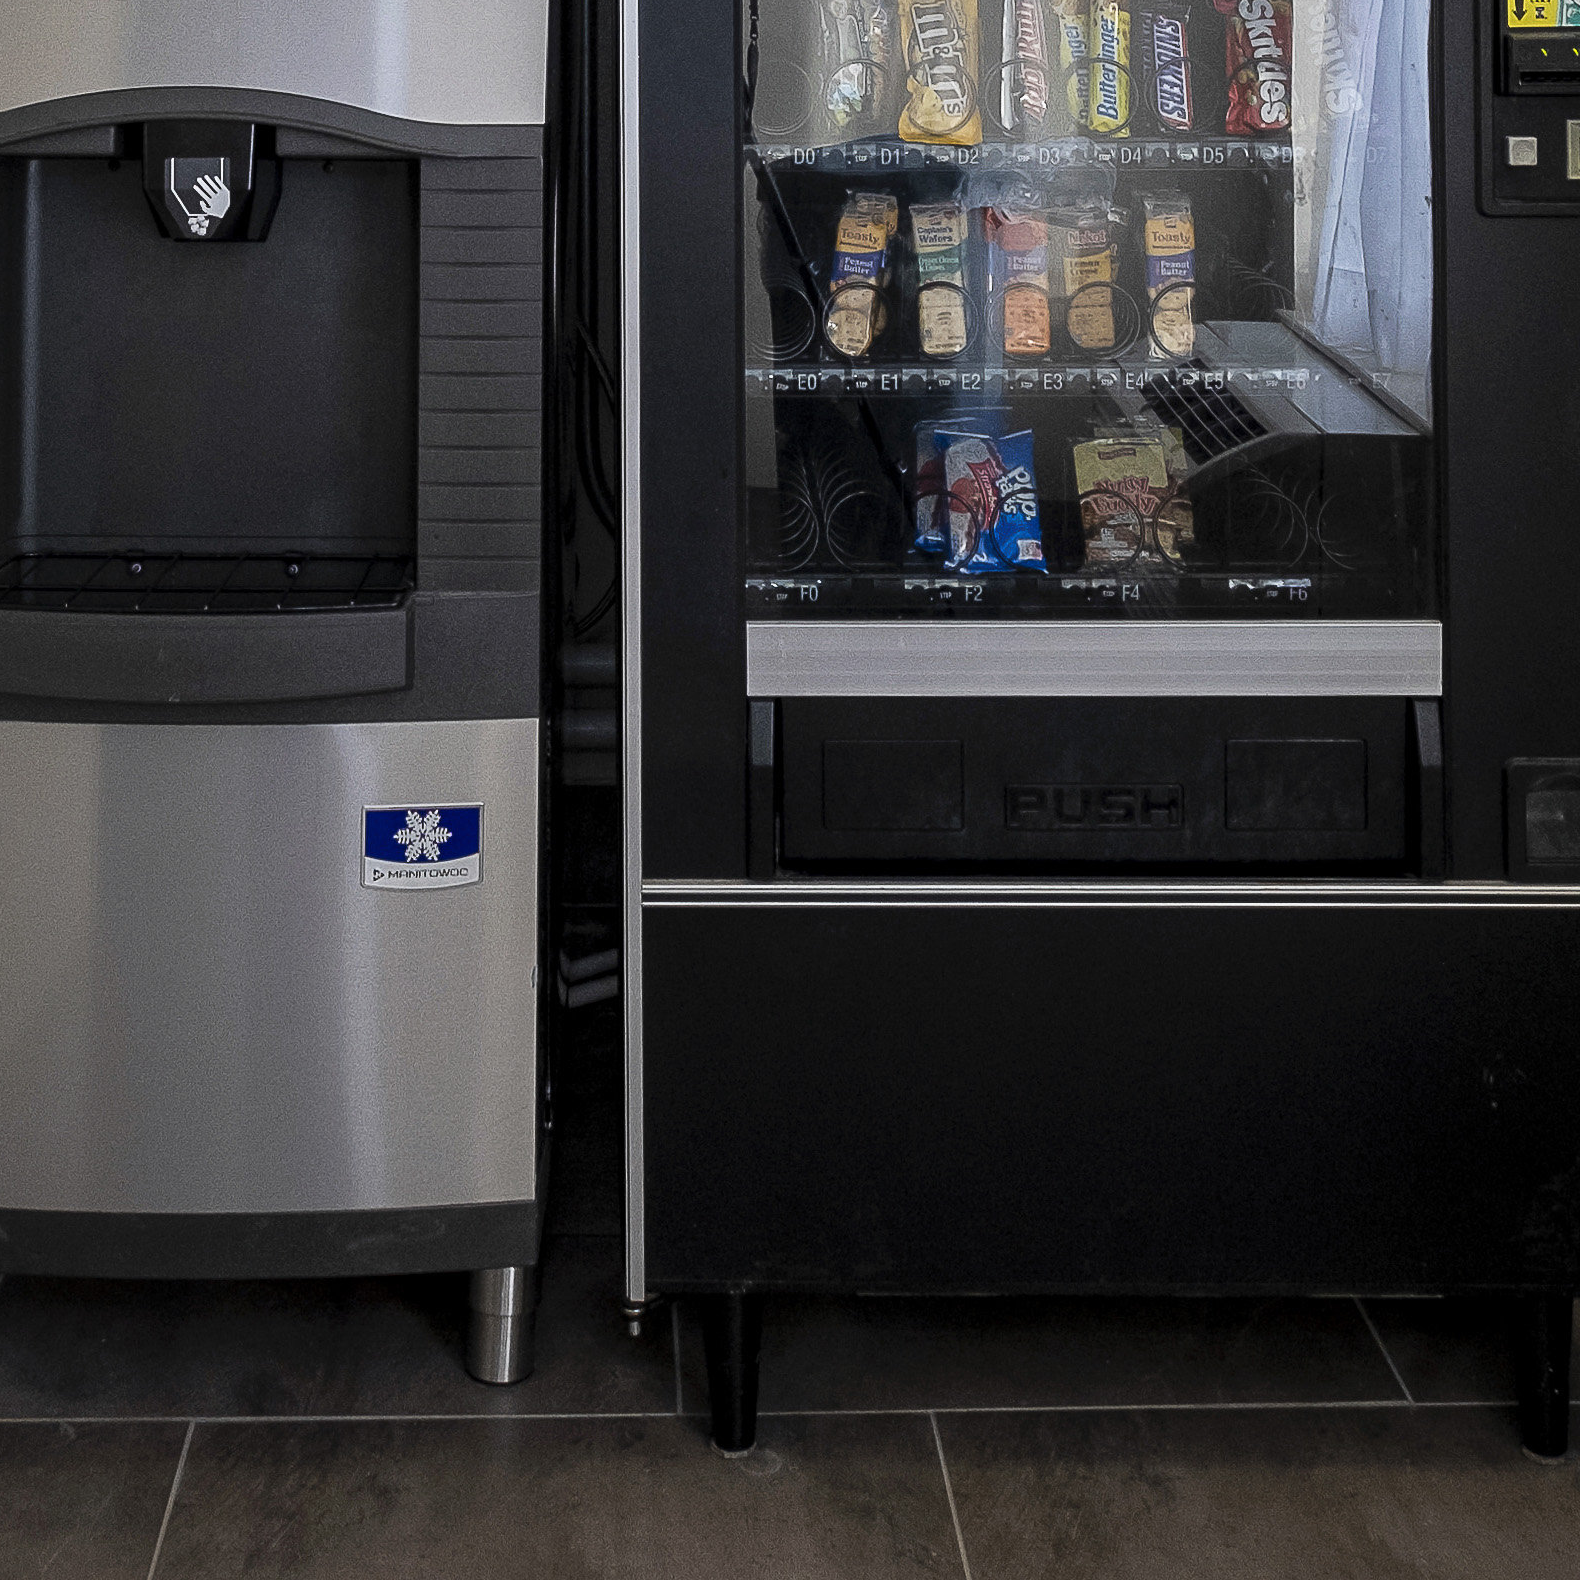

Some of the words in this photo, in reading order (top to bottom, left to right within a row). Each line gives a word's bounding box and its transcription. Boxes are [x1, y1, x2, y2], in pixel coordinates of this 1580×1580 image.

[881, 148, 901, 165] D1
[958, 148, 979, 165] D2
[1039, 148, 1060, 164] D3
[1121, 147, 1141, 164] D4
[1203, 147, 1224, 164] D5
[841, 227, 880, 245] Toasty
[917, 226, 953, 235] Captain's
[1152, 231, 1191, 244] Toasty
[919, 235, 953, 243] Wafers
[843, 264, 870, 275] Butter
[844, 256, 874, 268] Peanut
[1160, 259, 1190, 269] Peanut
[1161, 268, 1187, 276] Butter
[881, 374, 898, 390] E1
[962, 374, 981, 390] E2
[1044, 373, 1063, 390] E3
[1125, 373, 1144, 390] E4
[1205, 373, 1223, 390] E5
[965, 585, 983, 602] F2
[1122, 585, 1140, 602] F4
[1009, 786, 1180, 826] PUSH
[387, 868, 469, 879] MANITOWOC
